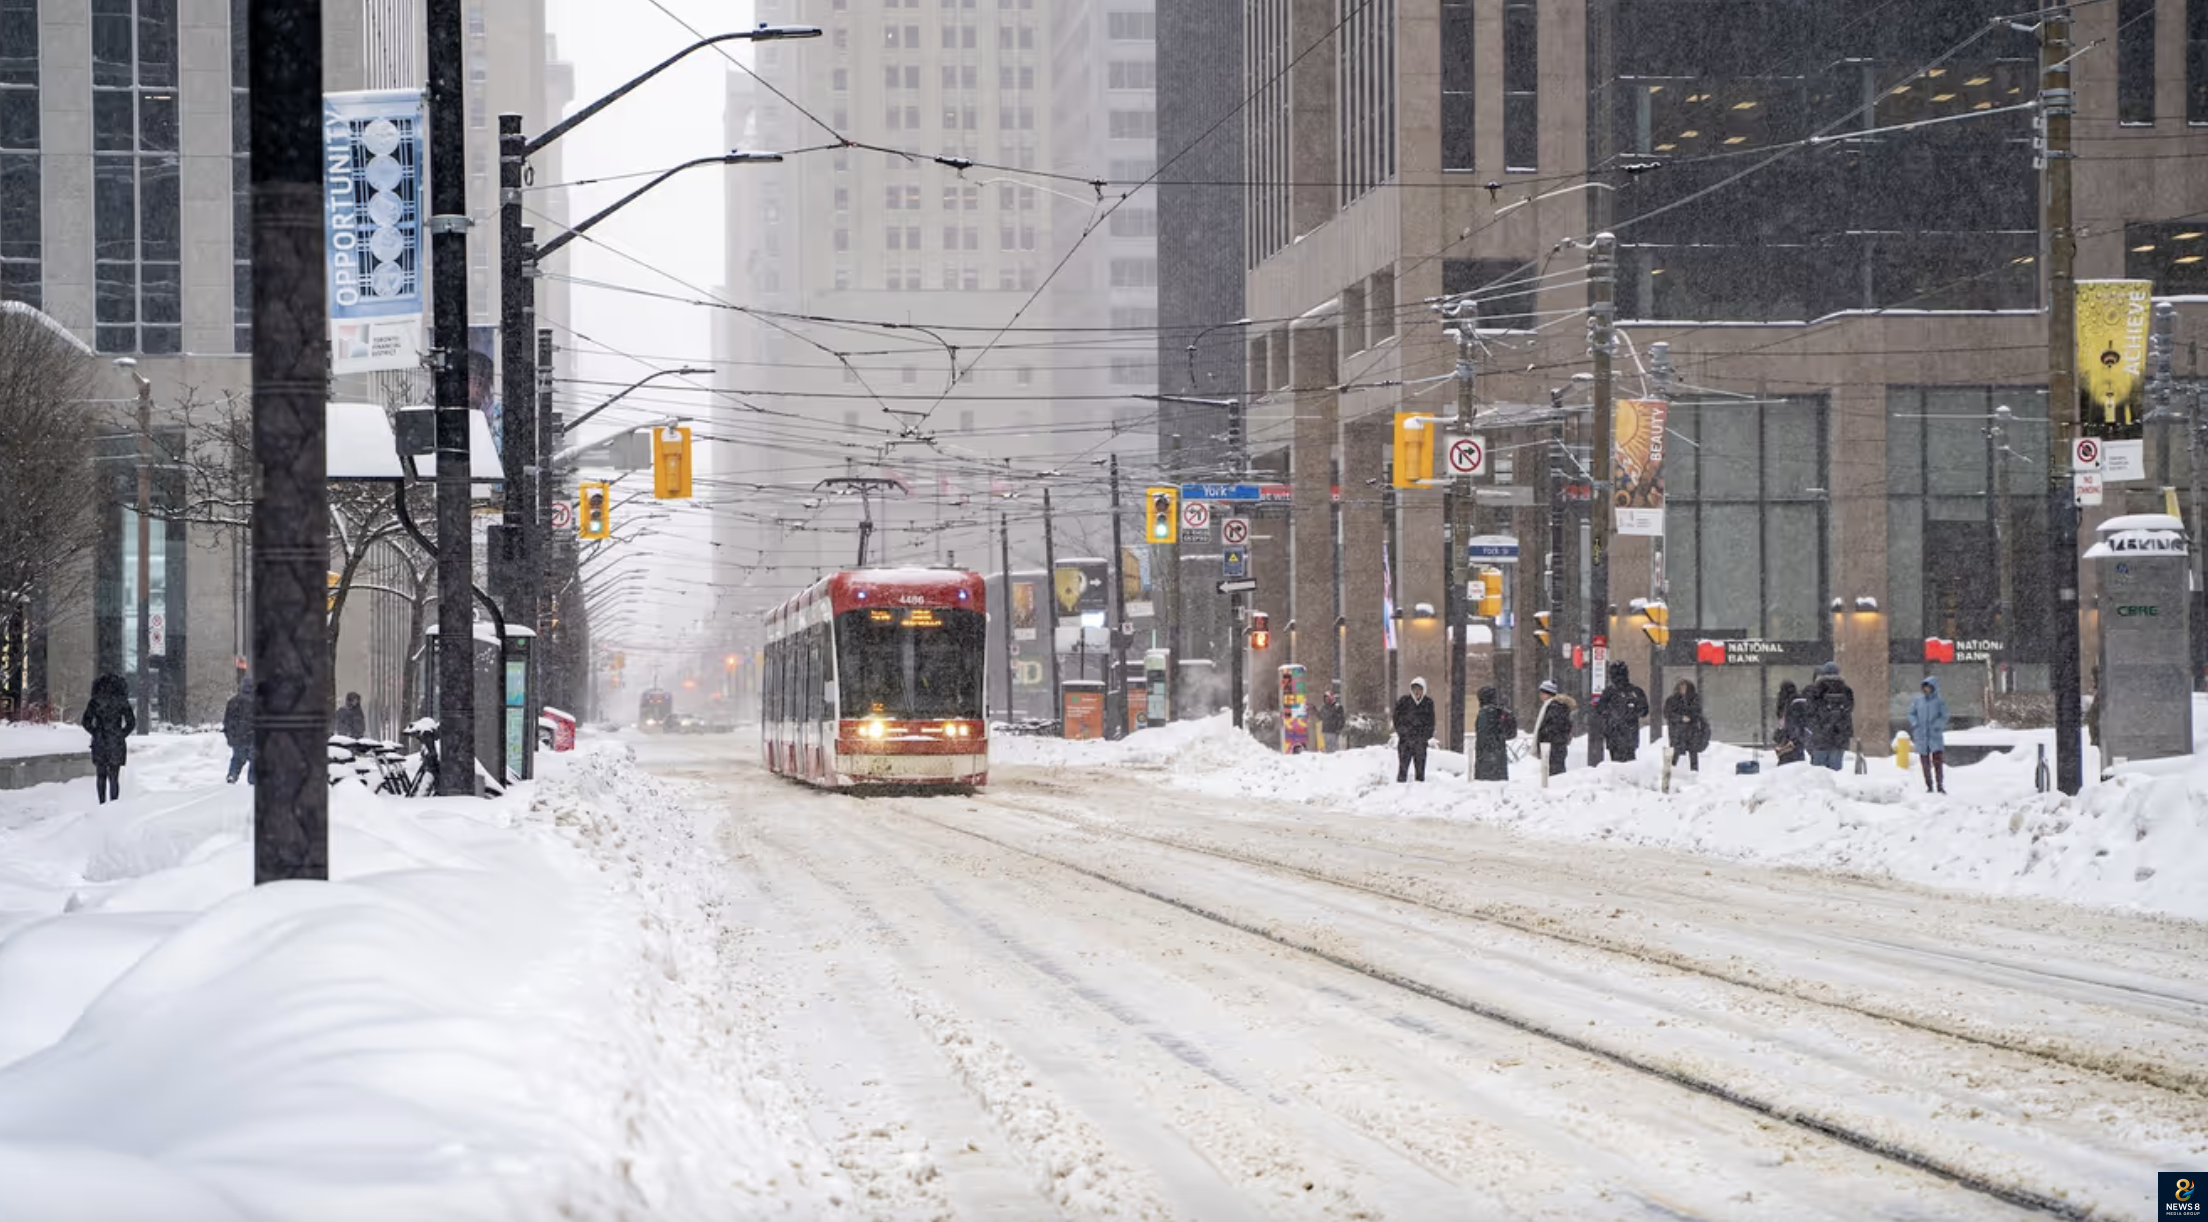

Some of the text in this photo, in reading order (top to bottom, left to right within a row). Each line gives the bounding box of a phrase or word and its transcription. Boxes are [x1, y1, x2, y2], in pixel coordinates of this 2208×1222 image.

[326, 110, 359, 307] OPPORTUNITY
[2124, 291, 2146, 376] ACHIEVE
[1649, 407, 1664, 461] BEAUTY
[2083, 476, 2093, 484] NO
[1203, 485, 1228, 497] York
[2117, 606, 2158, 617] CBRE
[1728, 641, 1783, 652] NATIONAL
[1728, 654, 1759, 663] BANK
